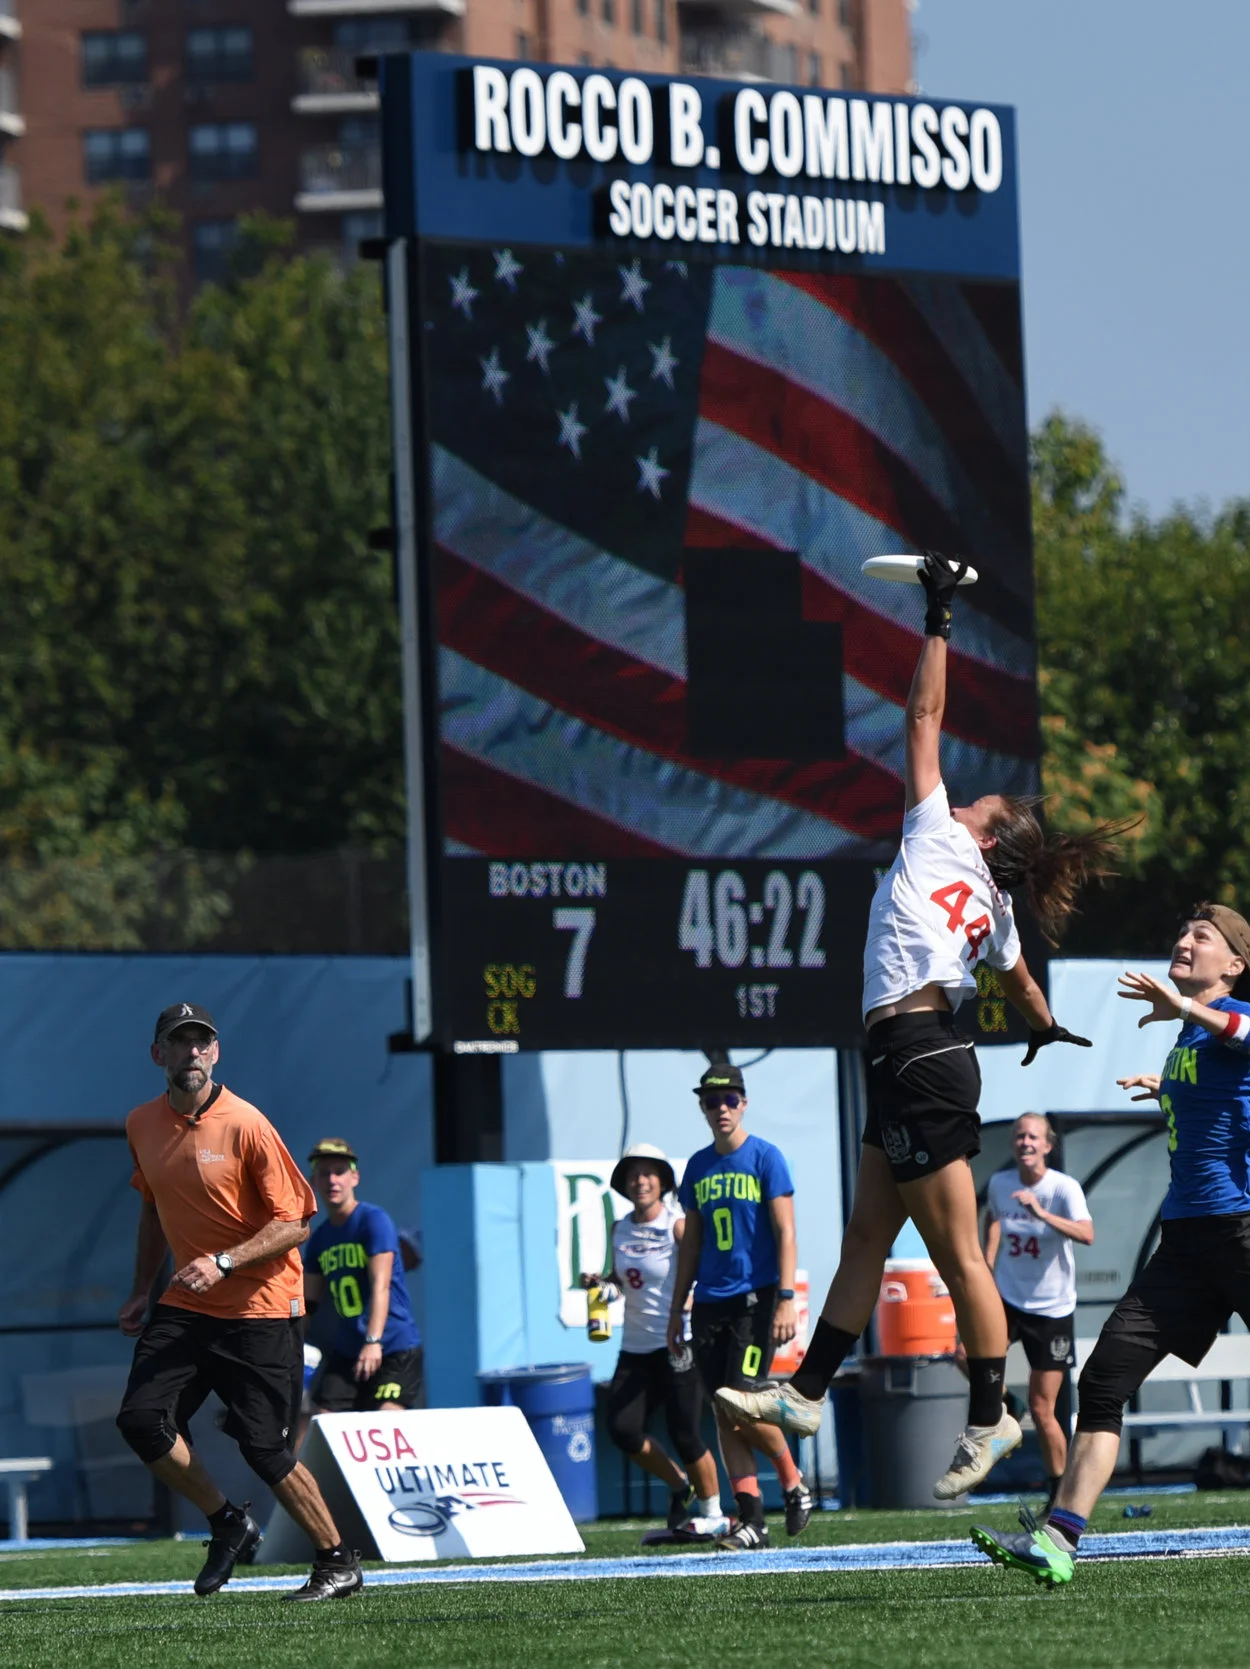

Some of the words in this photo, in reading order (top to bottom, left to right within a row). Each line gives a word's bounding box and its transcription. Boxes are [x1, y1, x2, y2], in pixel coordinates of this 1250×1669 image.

[473, 65, 653, 165] ROCCO
[669, 83, 720, 169] B.
[734, 88, 1001, 193] COMMISSO
[609, 179, 739, 243] SOCCER
[747, 191, 886, 254] STADIUM
[489, 862, 607, 897] BOSTON
[678, 868, 827, 969] 46:22
[930, 880, 991, 962] 44
[552, 906, 597, 999] 7
[484, 963, 537, 999] SOG
[735, 983, 780, 1018] 1ST
[713, 1207, 733, 1251] 0
[1007, 1233, 1041, 1259] 34
[318, 1243, 369, 1276] OSTON
[626, 1267, 644, 1290] 8
[330, 1275, 364, 1318] 10
[742, 1345, 762, 1377] 0
[342, 1428, 418, 1463] USA
[375, 1462, 510, 1495] ULTIMATE
